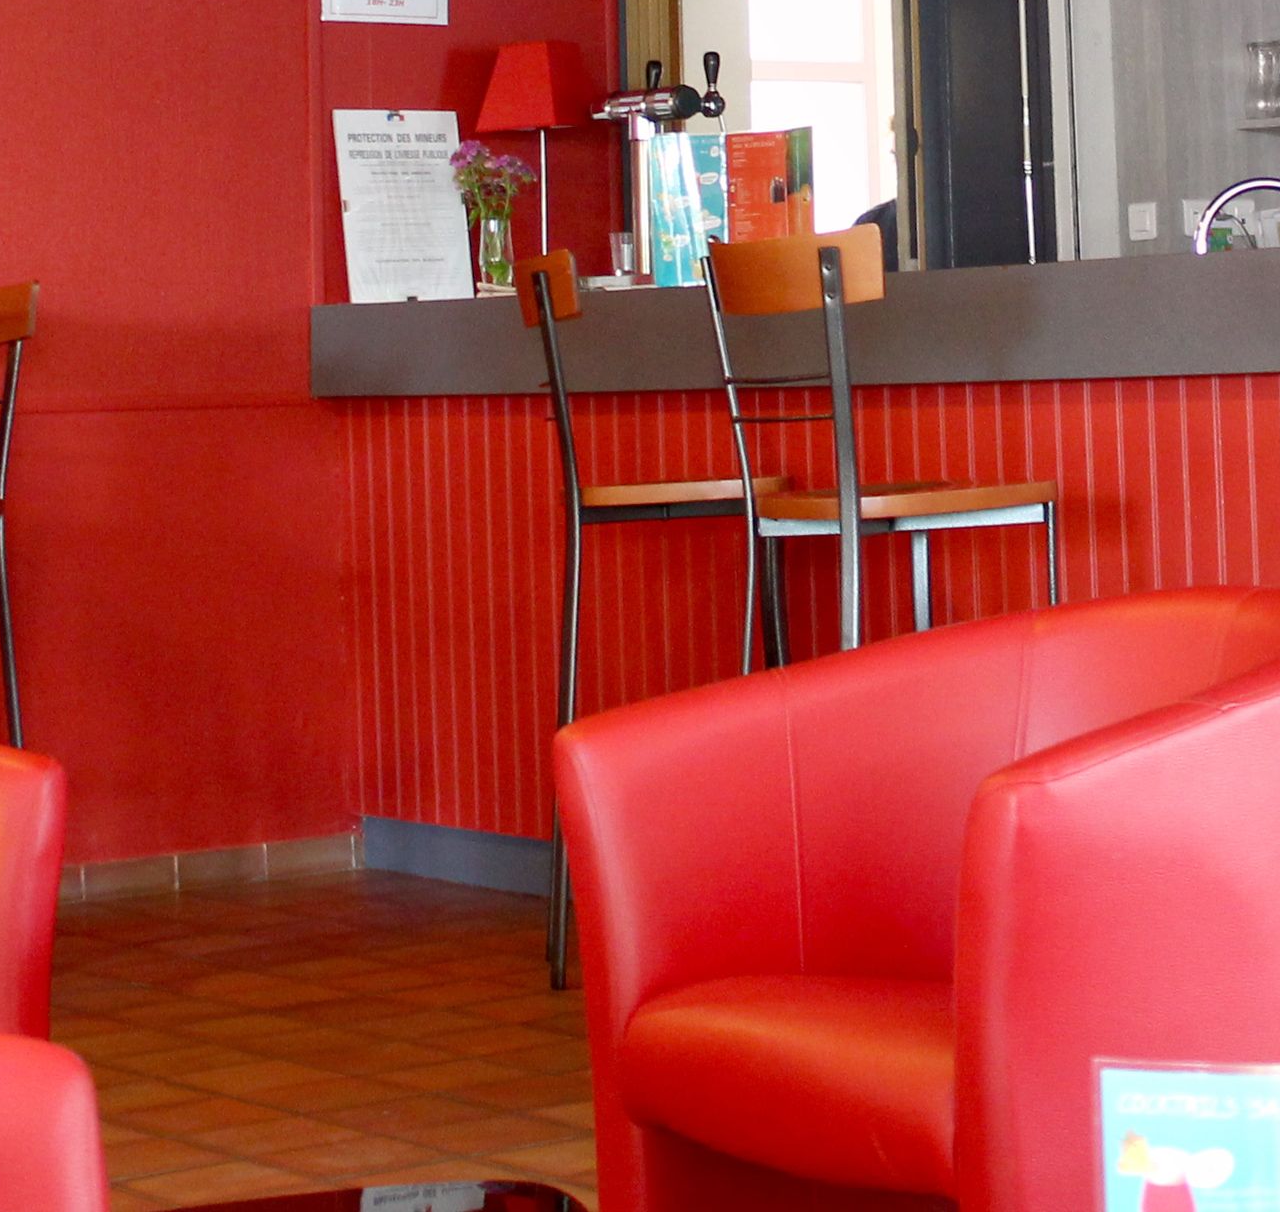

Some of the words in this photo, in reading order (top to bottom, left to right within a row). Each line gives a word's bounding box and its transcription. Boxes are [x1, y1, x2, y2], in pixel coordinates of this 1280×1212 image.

[347, 133, 393, 143] PROTECTION
[396, 133, 411, 143] DES
[415, 133, 448, 143] MINEURS
